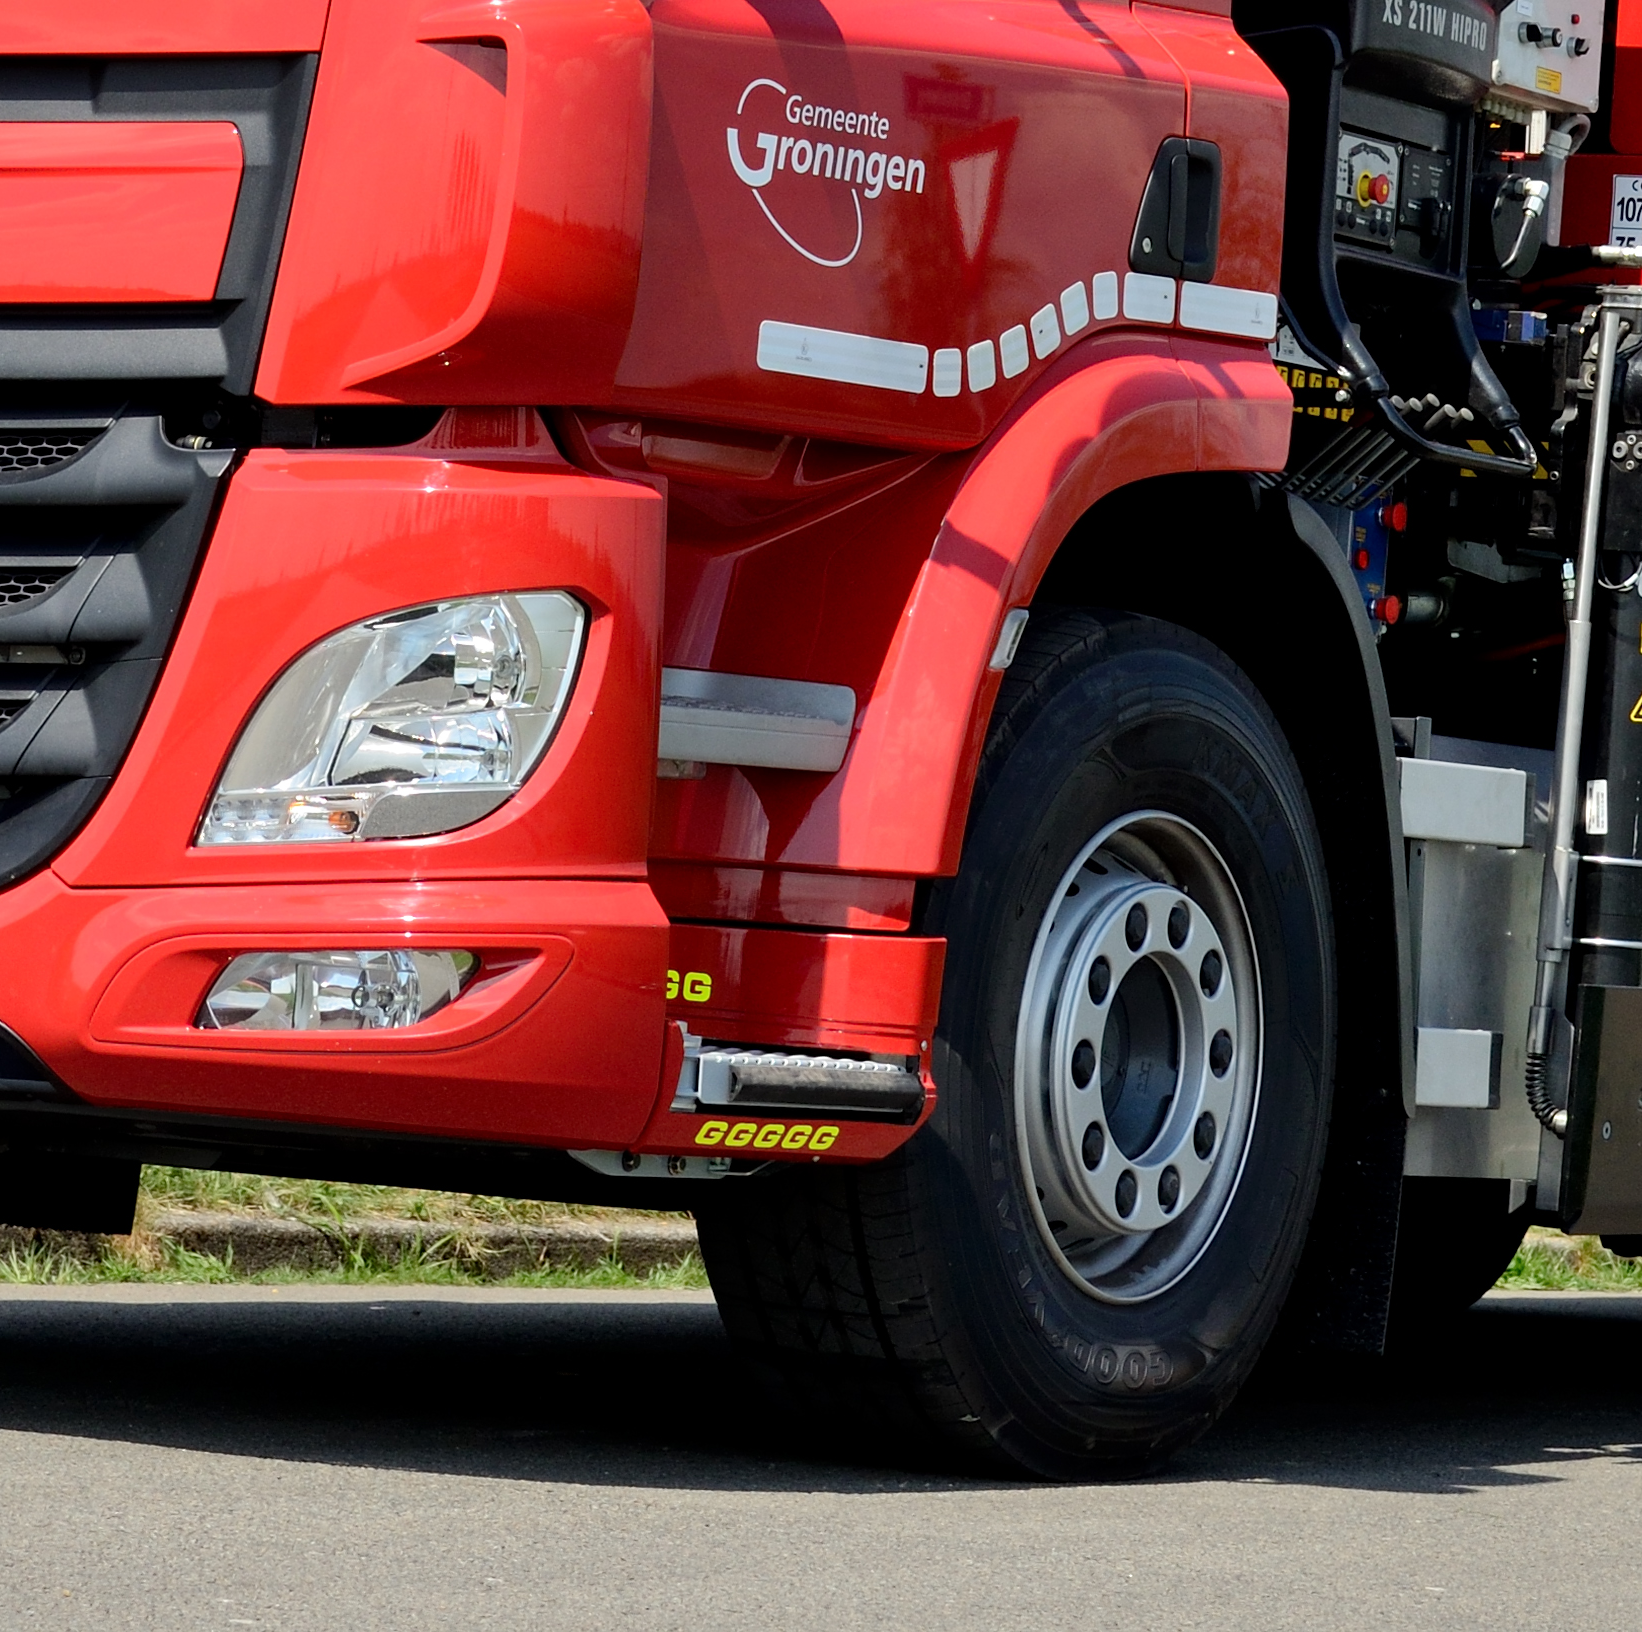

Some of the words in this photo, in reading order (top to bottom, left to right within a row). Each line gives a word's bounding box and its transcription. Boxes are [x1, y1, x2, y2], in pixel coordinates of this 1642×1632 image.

[1408, 0, 1447, 37] 211W
[1451, 11, 1487, 51] HIPRO
[785, 94, 890, 140] Gemeente
[726, 127, 926, 199] Groningen
[694, 1120, 840, 1151] GGGGG
